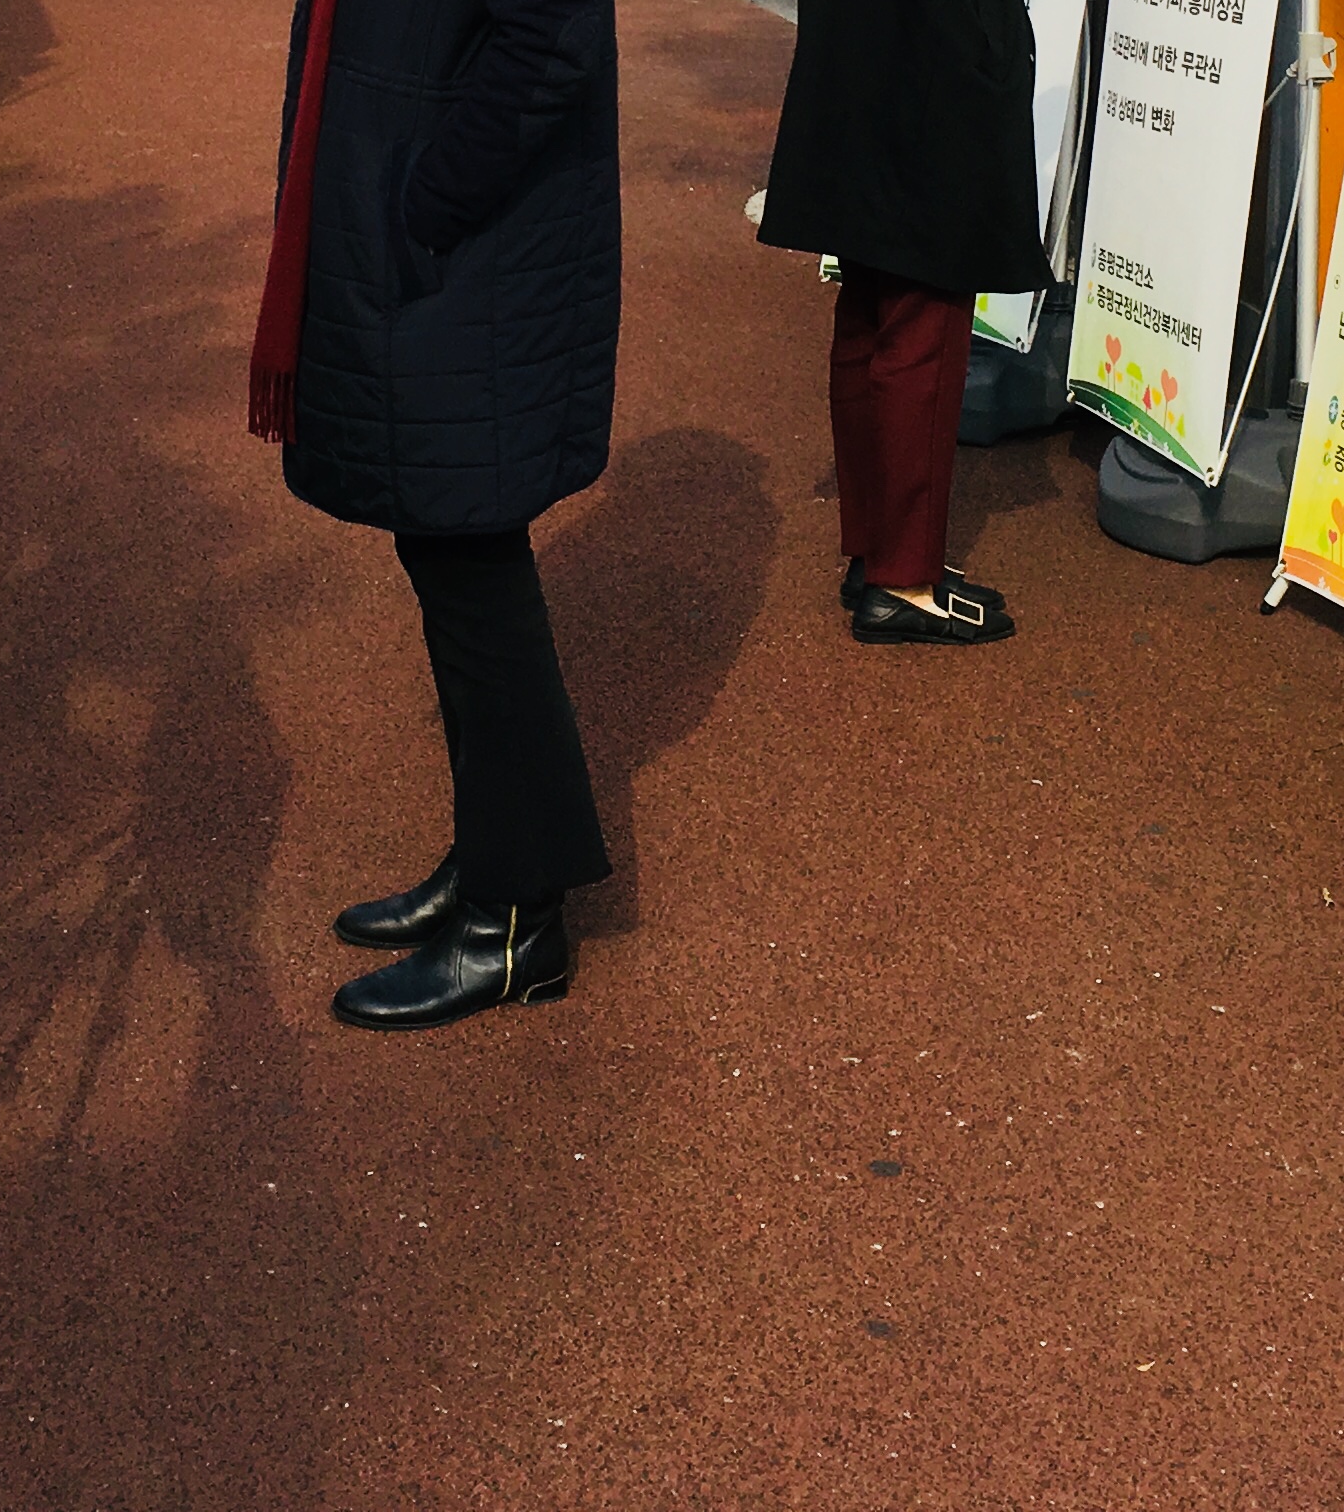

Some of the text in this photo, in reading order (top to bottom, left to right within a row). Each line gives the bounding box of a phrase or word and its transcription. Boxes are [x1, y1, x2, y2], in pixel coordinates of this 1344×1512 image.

[1152, 45, 1223, 85] 대한 무관심
[1151, 106, 1175, 136] 변화
[1098, 248, 1154, 290] 증평군보건소
[1097, 285, 1202, 352] 증평군정신건강복지센터
